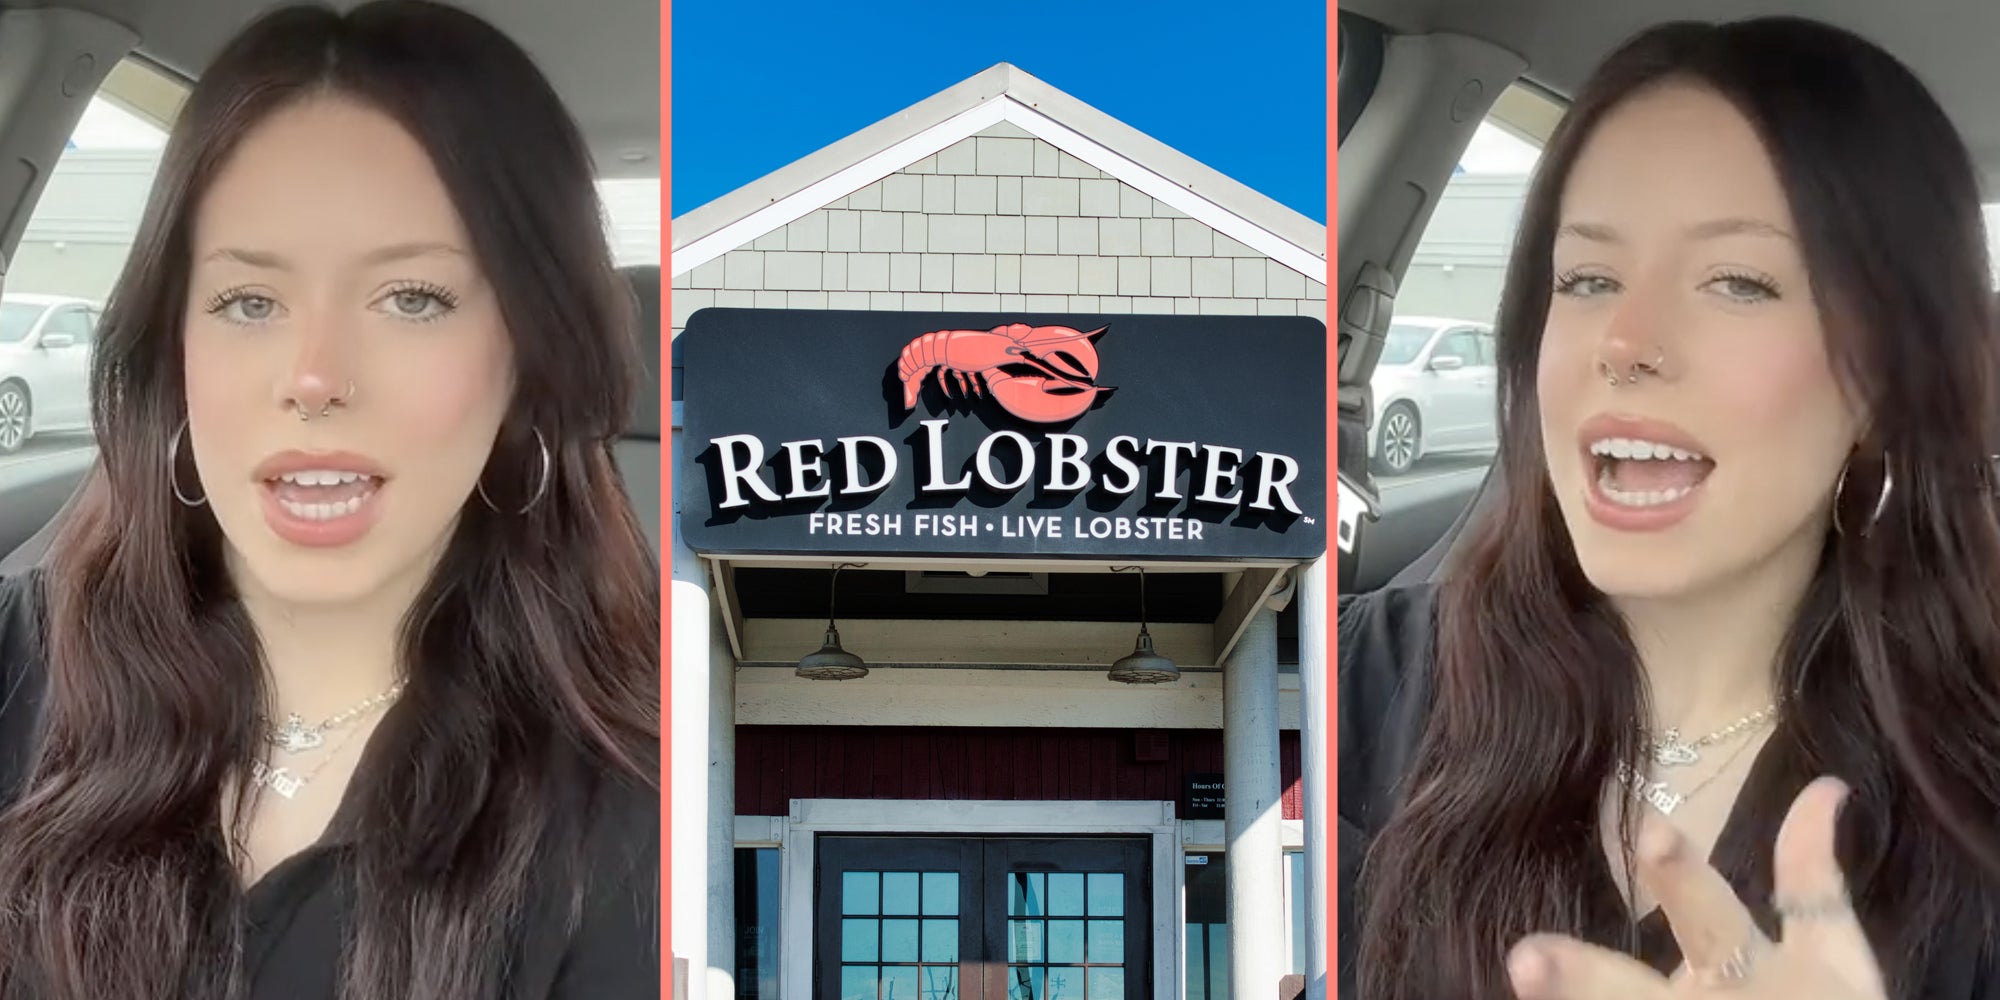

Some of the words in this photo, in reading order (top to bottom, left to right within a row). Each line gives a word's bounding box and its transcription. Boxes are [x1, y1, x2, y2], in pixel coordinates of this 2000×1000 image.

[809, 512, 902, 536] FRESH
[914, 513, 978, 537] FISH
[1001, 515, 1063, 539] LIVE
[1074, 516, 1204, 541] LOBSTER
[1192, 782, 1211, 790] Hours
[1212, 782, 1221, 790] Of
